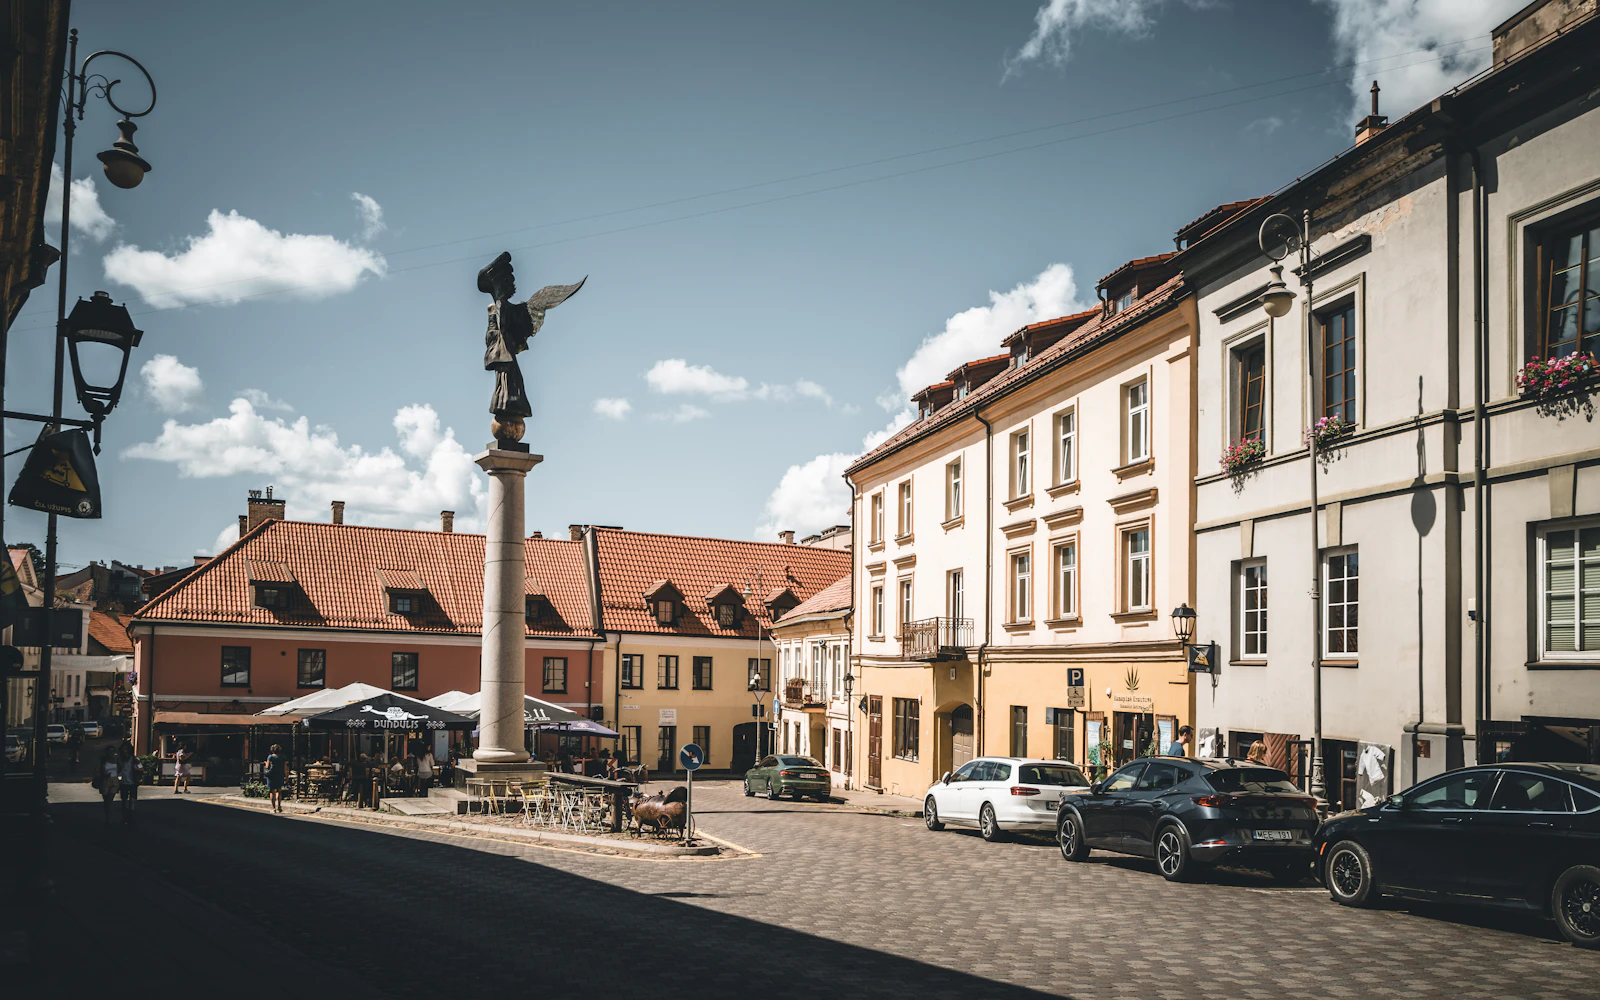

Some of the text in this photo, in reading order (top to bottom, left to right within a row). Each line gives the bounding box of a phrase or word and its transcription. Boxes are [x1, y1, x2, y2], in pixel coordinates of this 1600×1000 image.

[47, 504, 72, 513] UŽUPIS
[1072, 670, 1081, 685] P
[374, 720, 419, 729] DUNDULIS
[1257, 830, 1291, 839] MEE 191
